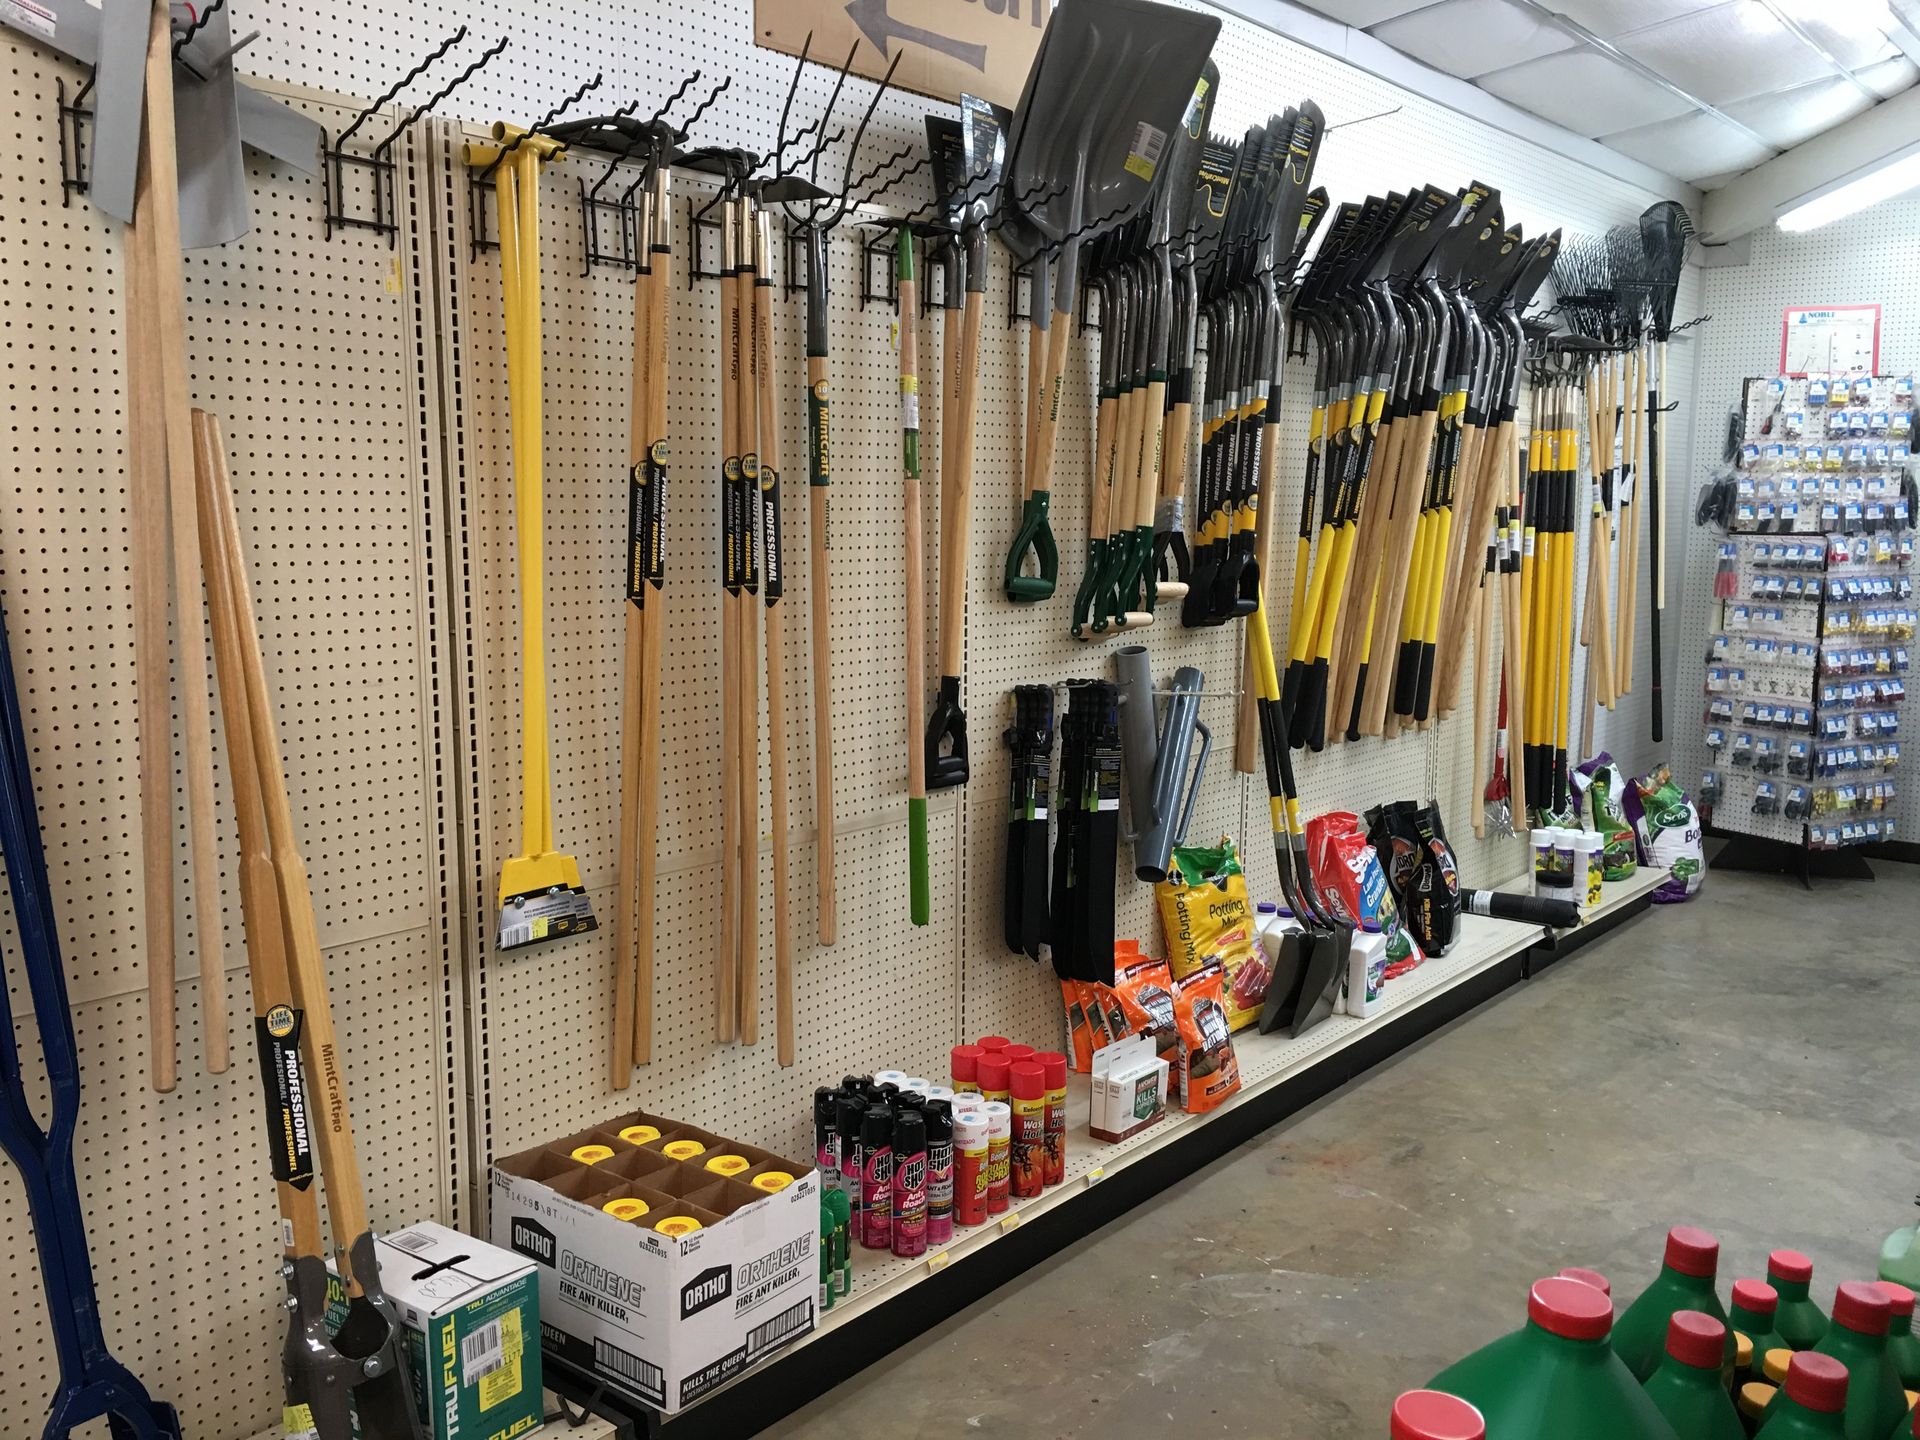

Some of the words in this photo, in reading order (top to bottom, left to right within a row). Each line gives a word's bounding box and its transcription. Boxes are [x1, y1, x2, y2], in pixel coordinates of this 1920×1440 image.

[818, 386, 828, 394] 10
[1050, 375, 1062, 422] MintCraft
[819, 407, 829, 476] MintCraft
[1154, 429, 1162, 473] MintCraft
[1252, 427, 1263, 486] PROFESSIONAL
[1225, 434, 1235, 492] PROFESSIONAL
[765, 501, 777, 582] PROFESSIONAL
[633, 541, 641, 592] PROFESSIONEL
[1421, 864, 1432, 891] AMDRO
[1209, 900, 1245, 919] Potting
[1184, 942, 1196, 964] Mix
[270, 1017, 291, 1028] TIME
[271, 1009, 289, 1020] LIFE
[285, 1050, 308, 1156] PROFESSIONAL
[321, 1043, 342, 1133] MintCraftPRO
[1136, 1086, 1157, 1104] KILLS
[273, 1042, 287, 1101] PROFESIONAL
[282, 1108, 297, 1172] PROFESSIONEL
[1023, 1120, 1044, 1130] Was
[875, 1152, 892, 1168] HO
[907, 1158, 926, 1175] HOT
[931, 1144, 953, 1161] HOT
[494, 1171, 501, 1187] 12
[877, 1185, 891, 1194] Ant
[903, 1196, 925, 1209] Roach
[515, 1225, 551, 1259] ORTHO
[680, 1240, 688, 1258] 12
[737, 1231, 811, 1292] ORTHENE
[559, 1280, 578, 1299] FIRE
[578, 1289, 596, 1306] ANT
[561, 1249, 642, 1309] ORTHENE
[685, 1273, 726, 1311] ORTHO
[466, 1299, 485, 1312] TRU
[485, 1278, 527, 1303] ADVANTAGE
[735, 1293, 753, 1310] FIRE
[754, 1285, 771, 1300] ANT
[502, 1350, 521, 1366] 1177
[683, 1374, 704, 1393] KILLS
[705, 1365, 720, 1381] THE
[721, 1349, 746, 1373] QUEEN
[442, 1314, 461, 1440] TRUFUEL
[686, 1381, 711, 1400] DESTROYS
[712, 1376, 720, 1386] THE
[720, 1364, 739, 1381] MOUND
